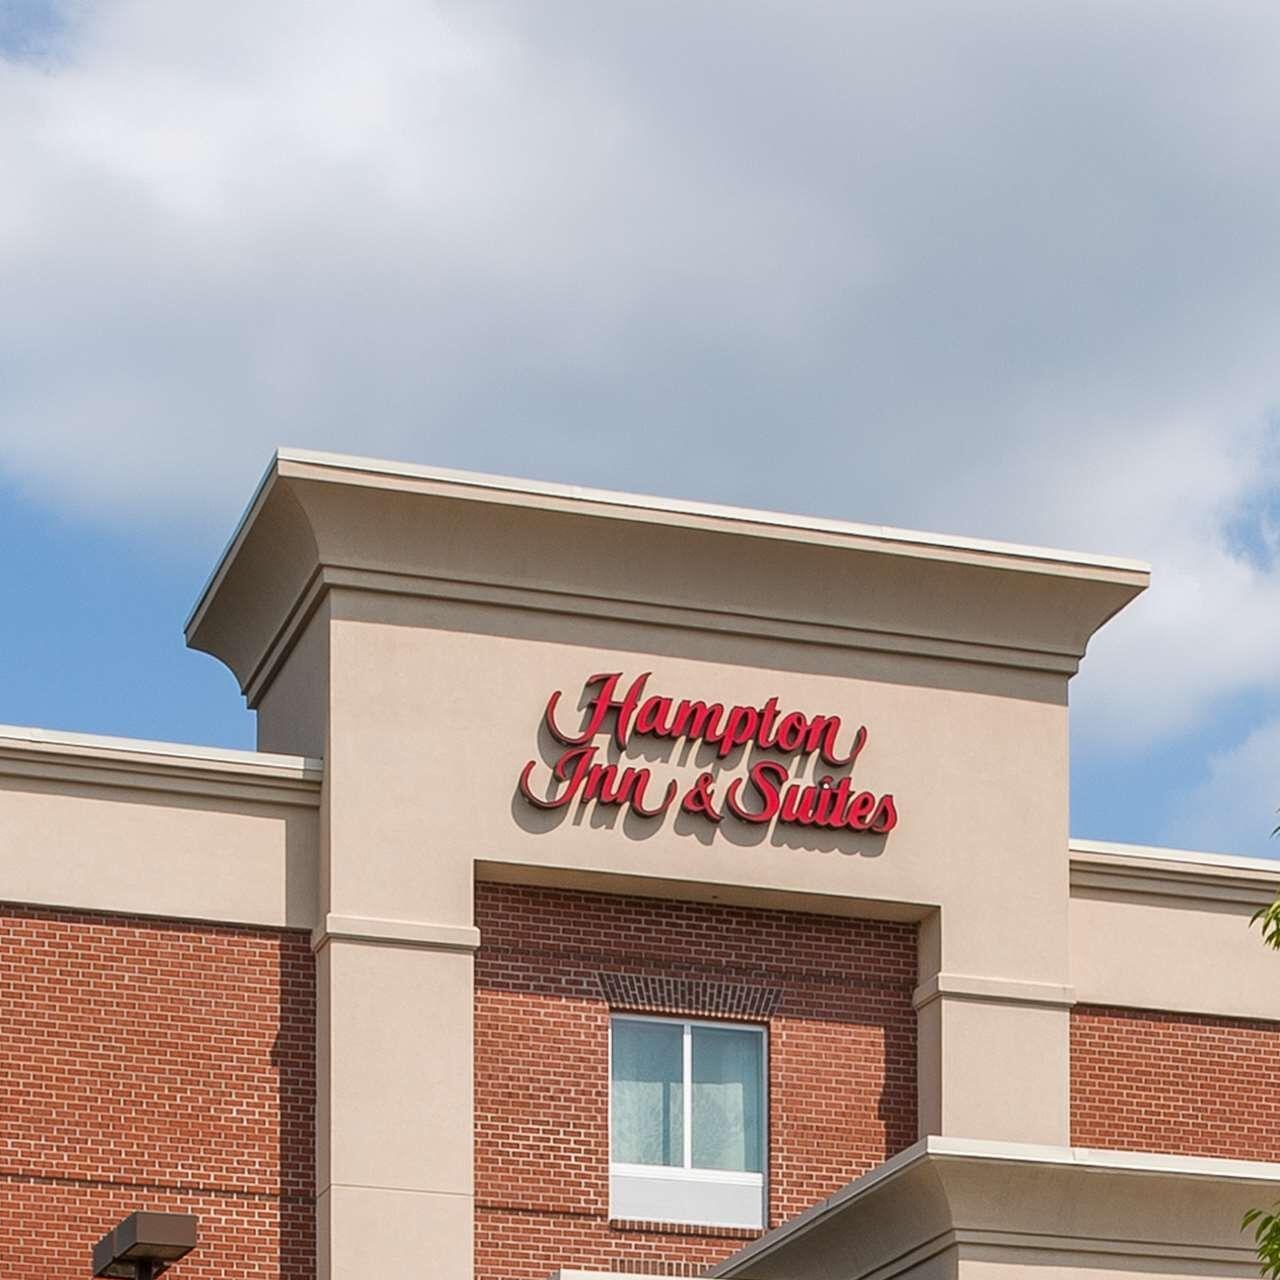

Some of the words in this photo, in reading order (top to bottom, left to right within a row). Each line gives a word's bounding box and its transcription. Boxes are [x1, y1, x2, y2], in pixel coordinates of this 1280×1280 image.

[546, 671, 867, 766] Hampton
[520, 746, 678, 817] Inn
[683, 773, 725, 823] &
[727, 760, 898, 834] Suites
